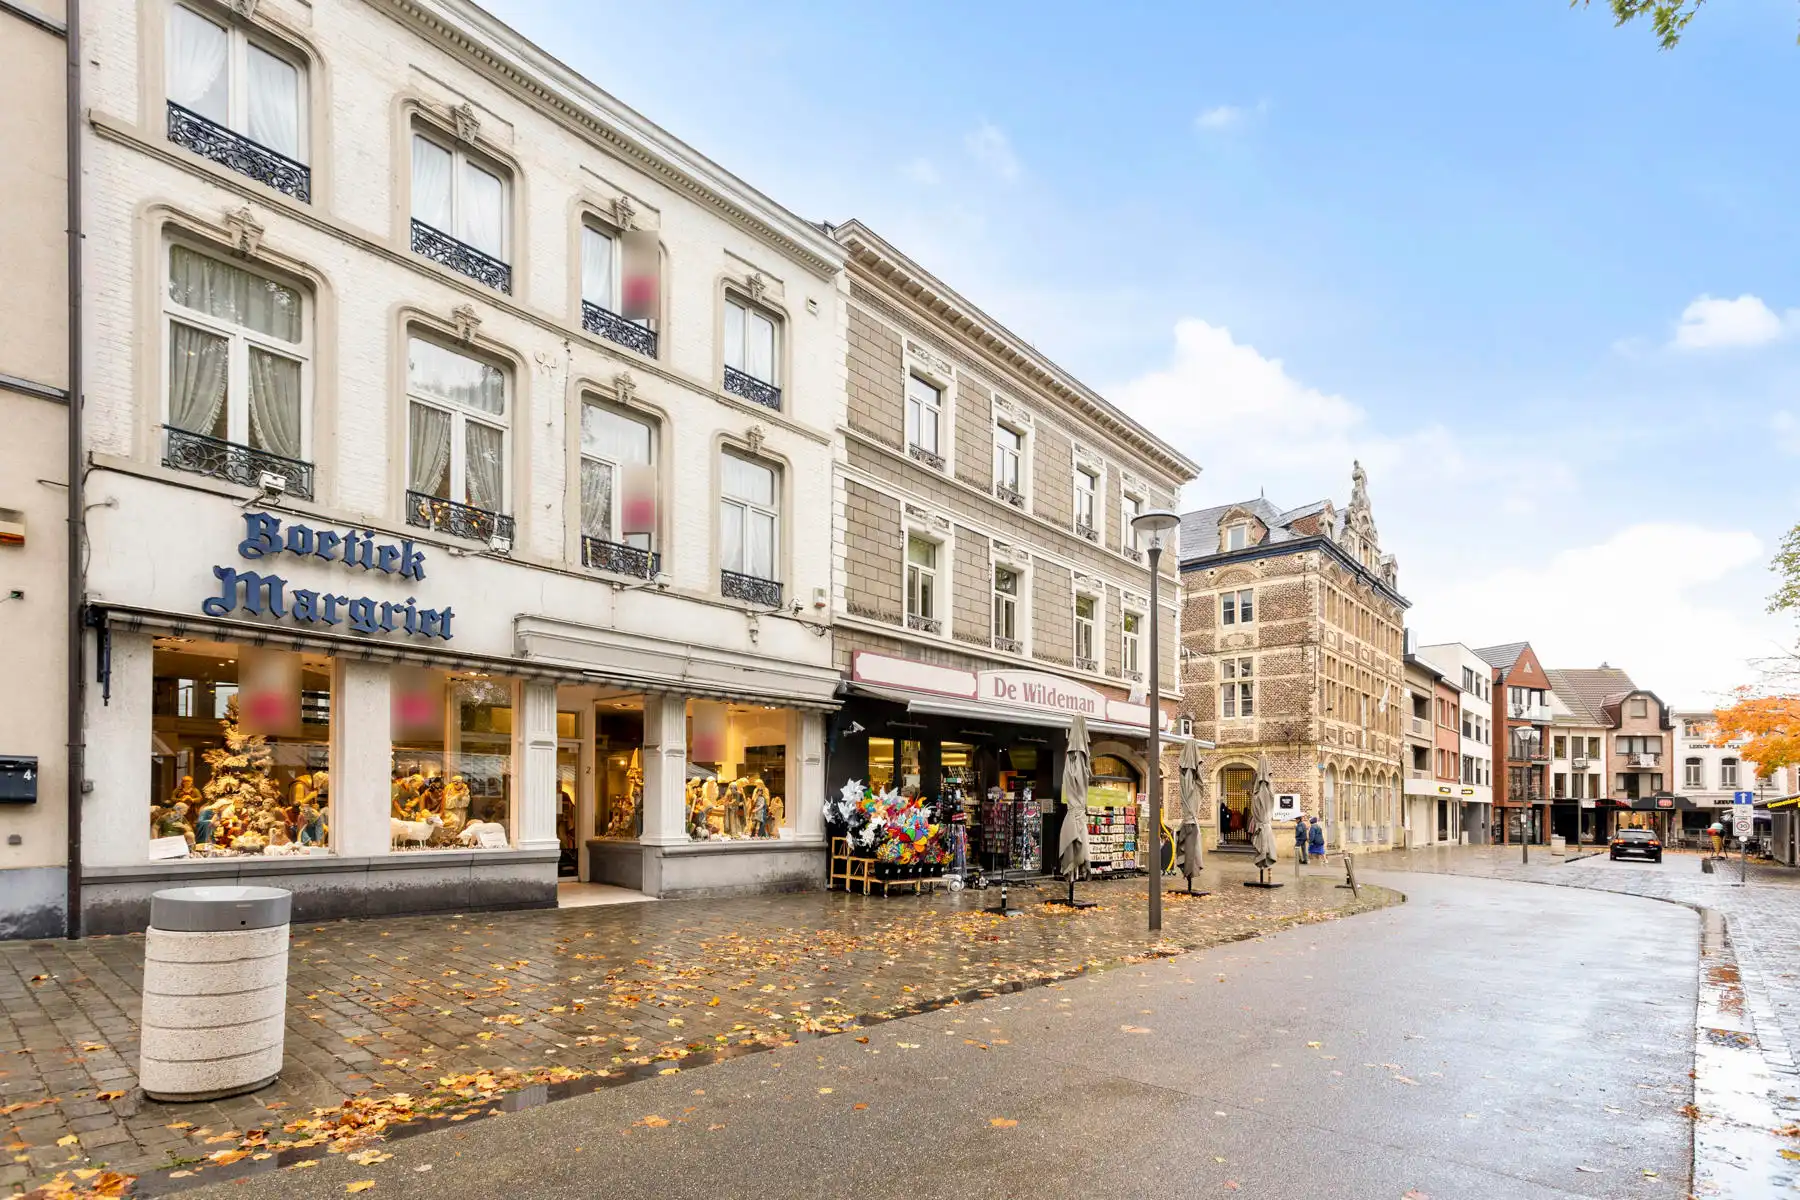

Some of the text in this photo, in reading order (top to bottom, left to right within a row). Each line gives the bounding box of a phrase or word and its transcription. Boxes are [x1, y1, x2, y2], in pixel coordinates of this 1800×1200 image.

[238, 511, 426, 581] Boetiek
[202, 565, 455, 640] Margriet
[994, 676, 1095, 713] De Wildeman
[23, 769, 32, 780] 4
